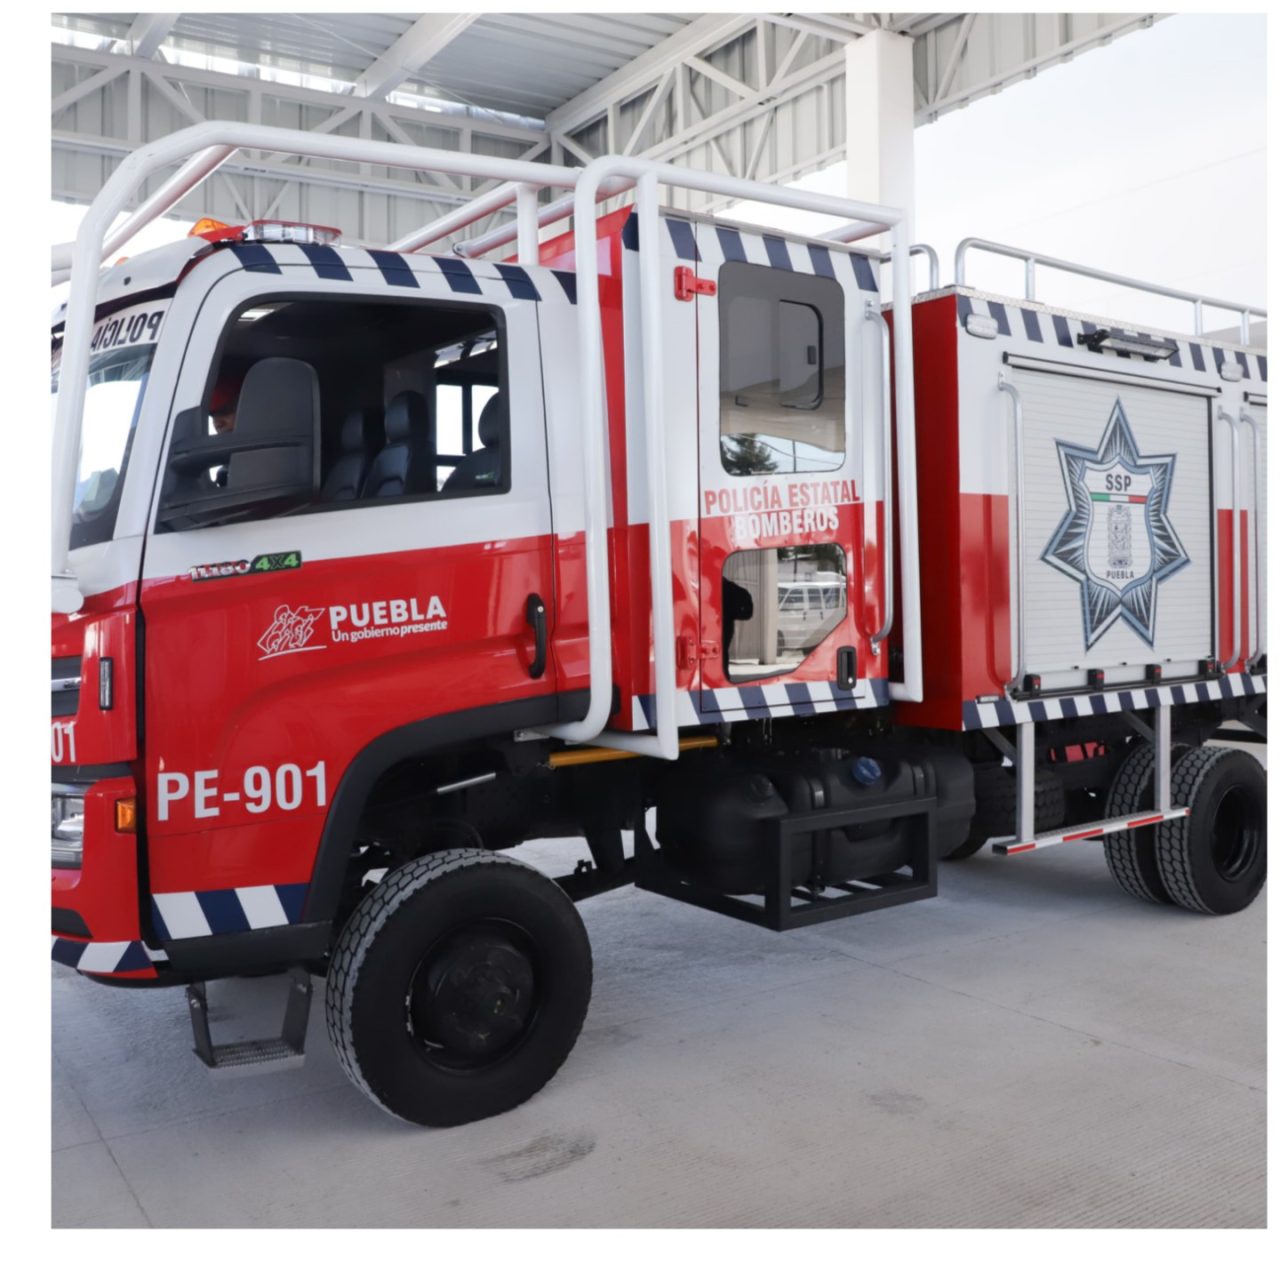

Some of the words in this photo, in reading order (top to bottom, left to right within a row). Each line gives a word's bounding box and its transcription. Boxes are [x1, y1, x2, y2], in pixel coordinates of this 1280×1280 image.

[704, 480, 783, 515] POLICÍA
[787, 479, 861, 508] ESTATAL
[1105, 473, 1132, 492] SSP
[734, 506, 840, 539] BOMBEROS
[1106, 570, 1135, 580] PUEBLA
[329, 595, 447, 630] PUEBLA
[332, 630, 349, 642] Un
[350, 625, 400, 643] gobierno
[400, 620, 448, 638] presente
[157, 760, 327, 822] PE-901
